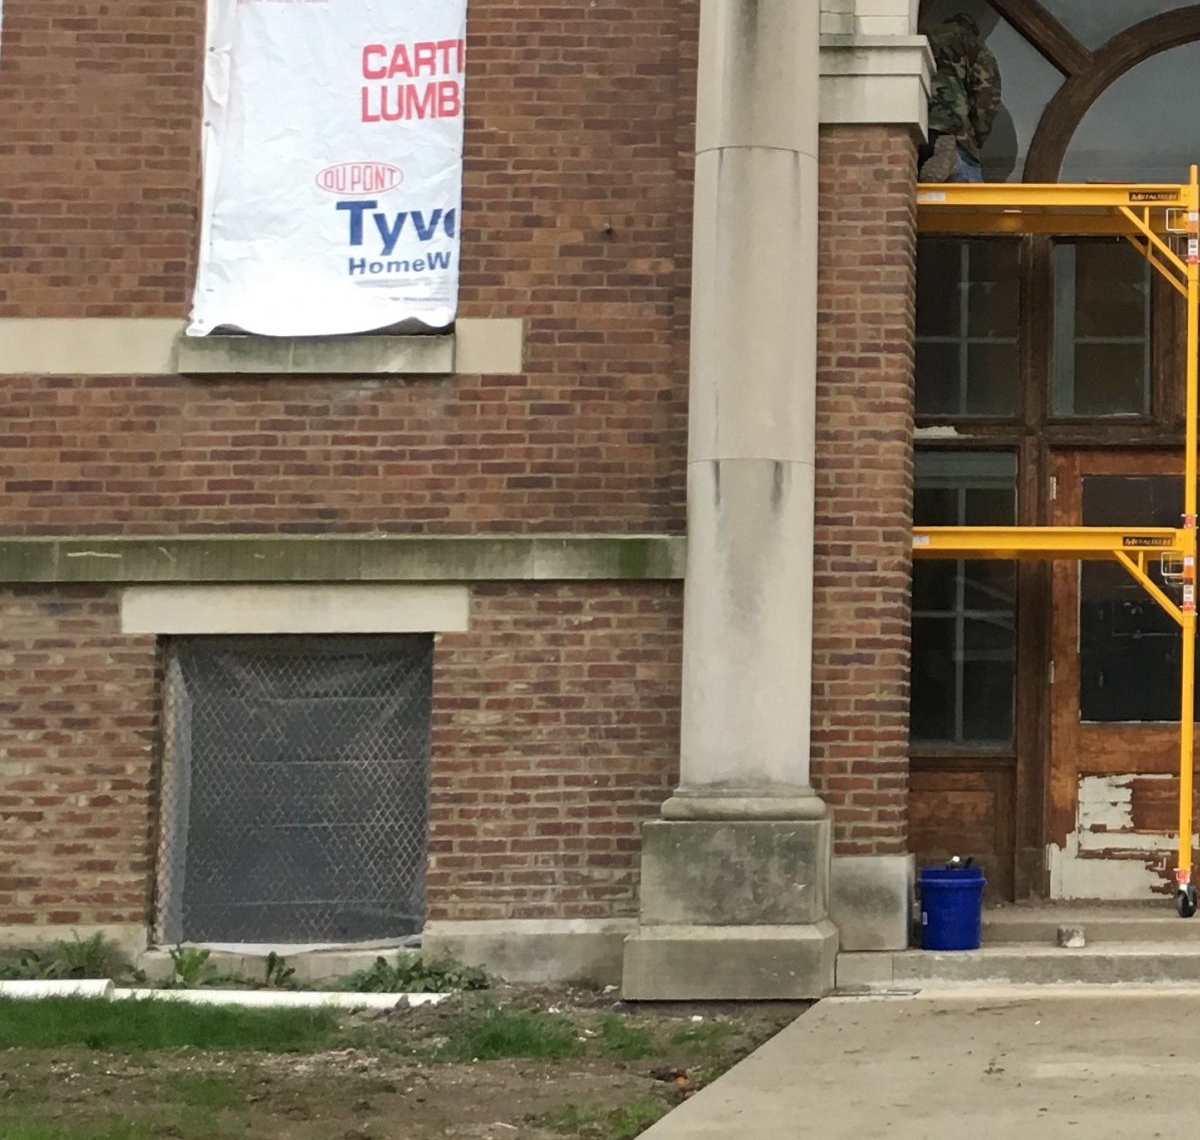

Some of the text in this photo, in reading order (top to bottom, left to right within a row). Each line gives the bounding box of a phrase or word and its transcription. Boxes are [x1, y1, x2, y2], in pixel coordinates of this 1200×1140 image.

[362, 38, 464, 80] CART
[361, 80, 460, 123] LUMB
[348, 251, 452, 276] HomeW
